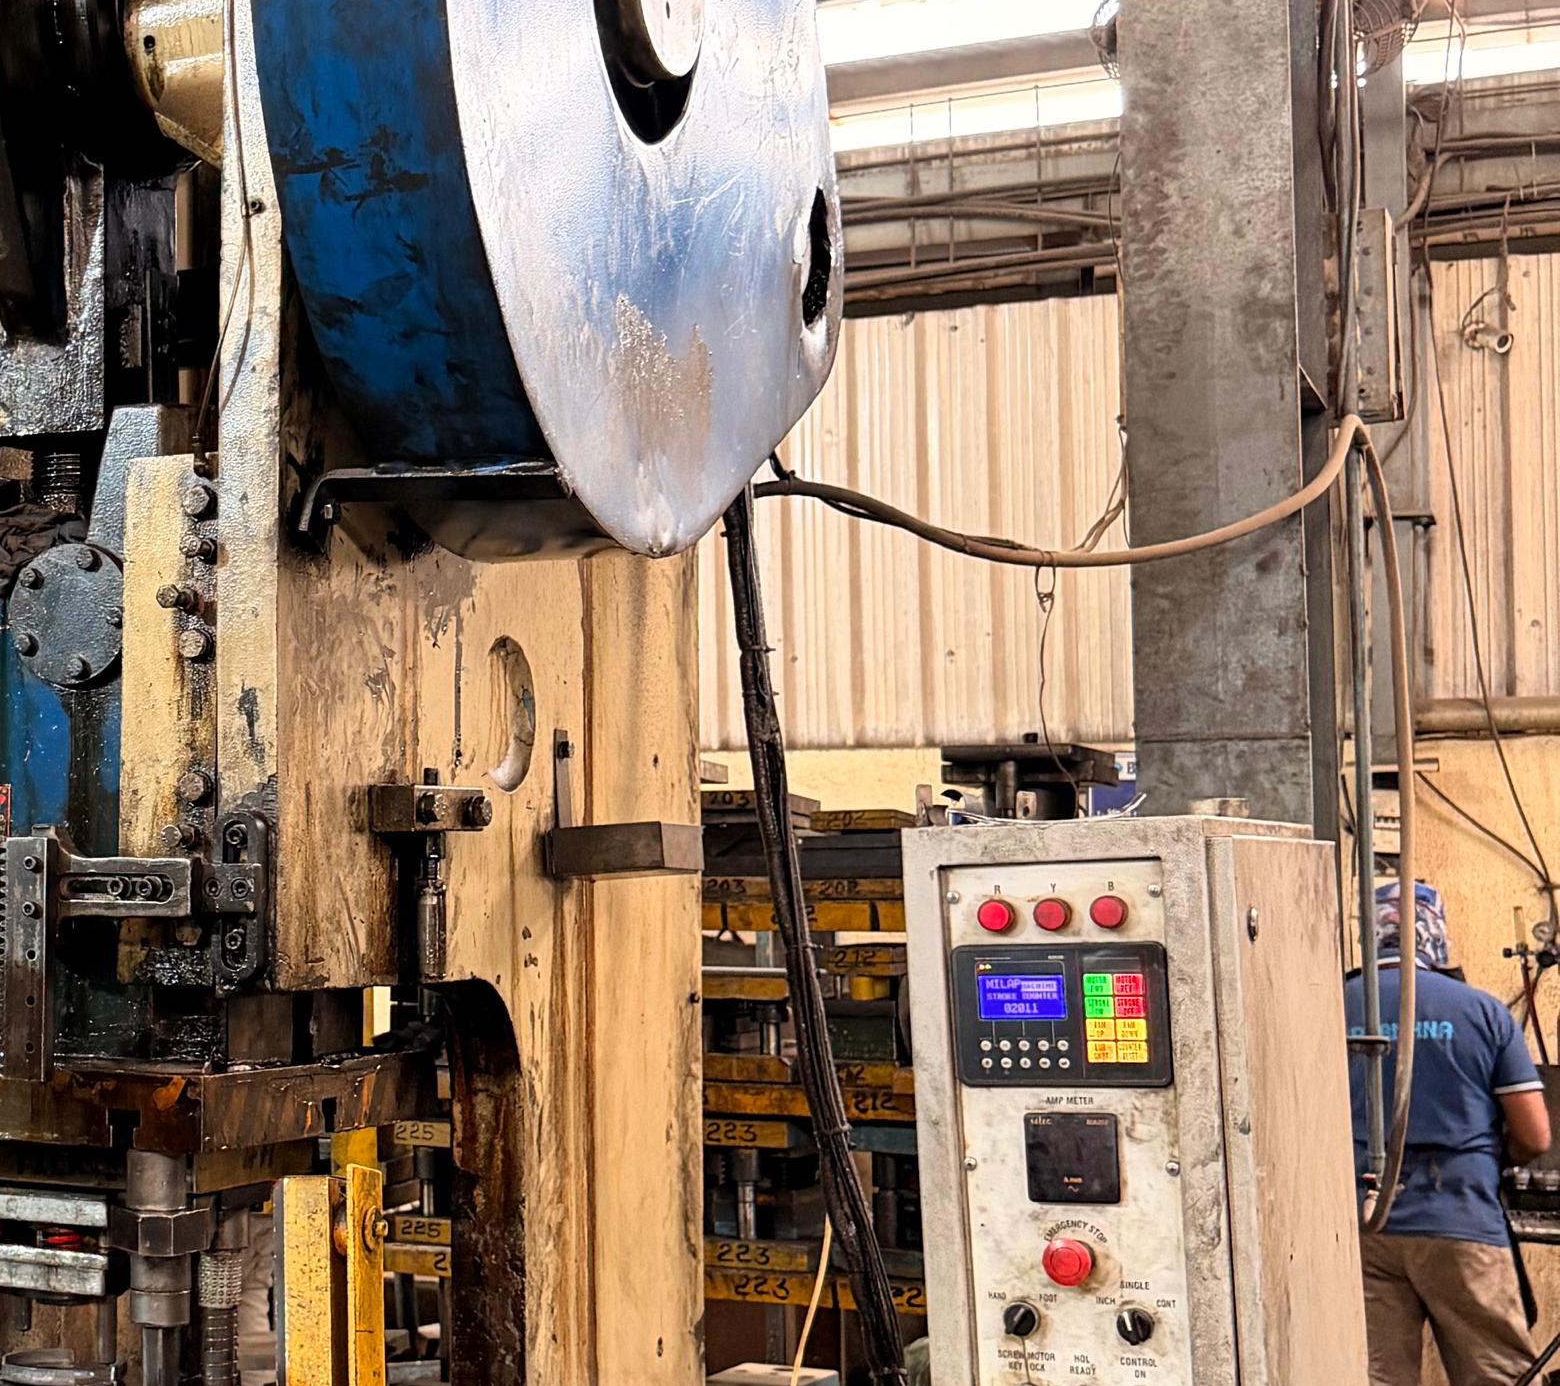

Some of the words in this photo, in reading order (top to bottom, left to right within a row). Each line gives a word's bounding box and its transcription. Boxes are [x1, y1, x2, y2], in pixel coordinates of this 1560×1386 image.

[709, 790, 751, 808] 203
[993, 884, 1002, 896] R
[1049, 882, 1057, 893] Y
[1107, 880, 1116, 892] B
[833, 948, 878, 968] 212
[985, 978, 1021, 990] MILAP
[853, 1093, 899, 1113] 212
[1046, 1096, 1064, 1105] AMP
[1066, 1096, 1094, 1105] METER
[395, 1123, 436, 1141] 225
[706, 1121, 758, 1143] 223
[401, 1219, 442, 1239] 225
[1043, 1219, 1088, 1242] EMERGENCY
[1088, 1225, 1108, 1244] STOP
[717, 1242, 771, 1264] 223
[733, 1275, 791, 1300] 223
[1119, 1280, 1151, 1291] SINGLE
[1038, 1293, 1058, 1304] FOOT
[1095, 1296, 1116, 1306] INCH
[1156, 1298, 1177, 1309] CONT
[1027, 1351, 1056, 1362] MOTOR
[1119, 1357, 1158, 1368] CONTROL
[1134, 1369, 1146, 1379] ON
